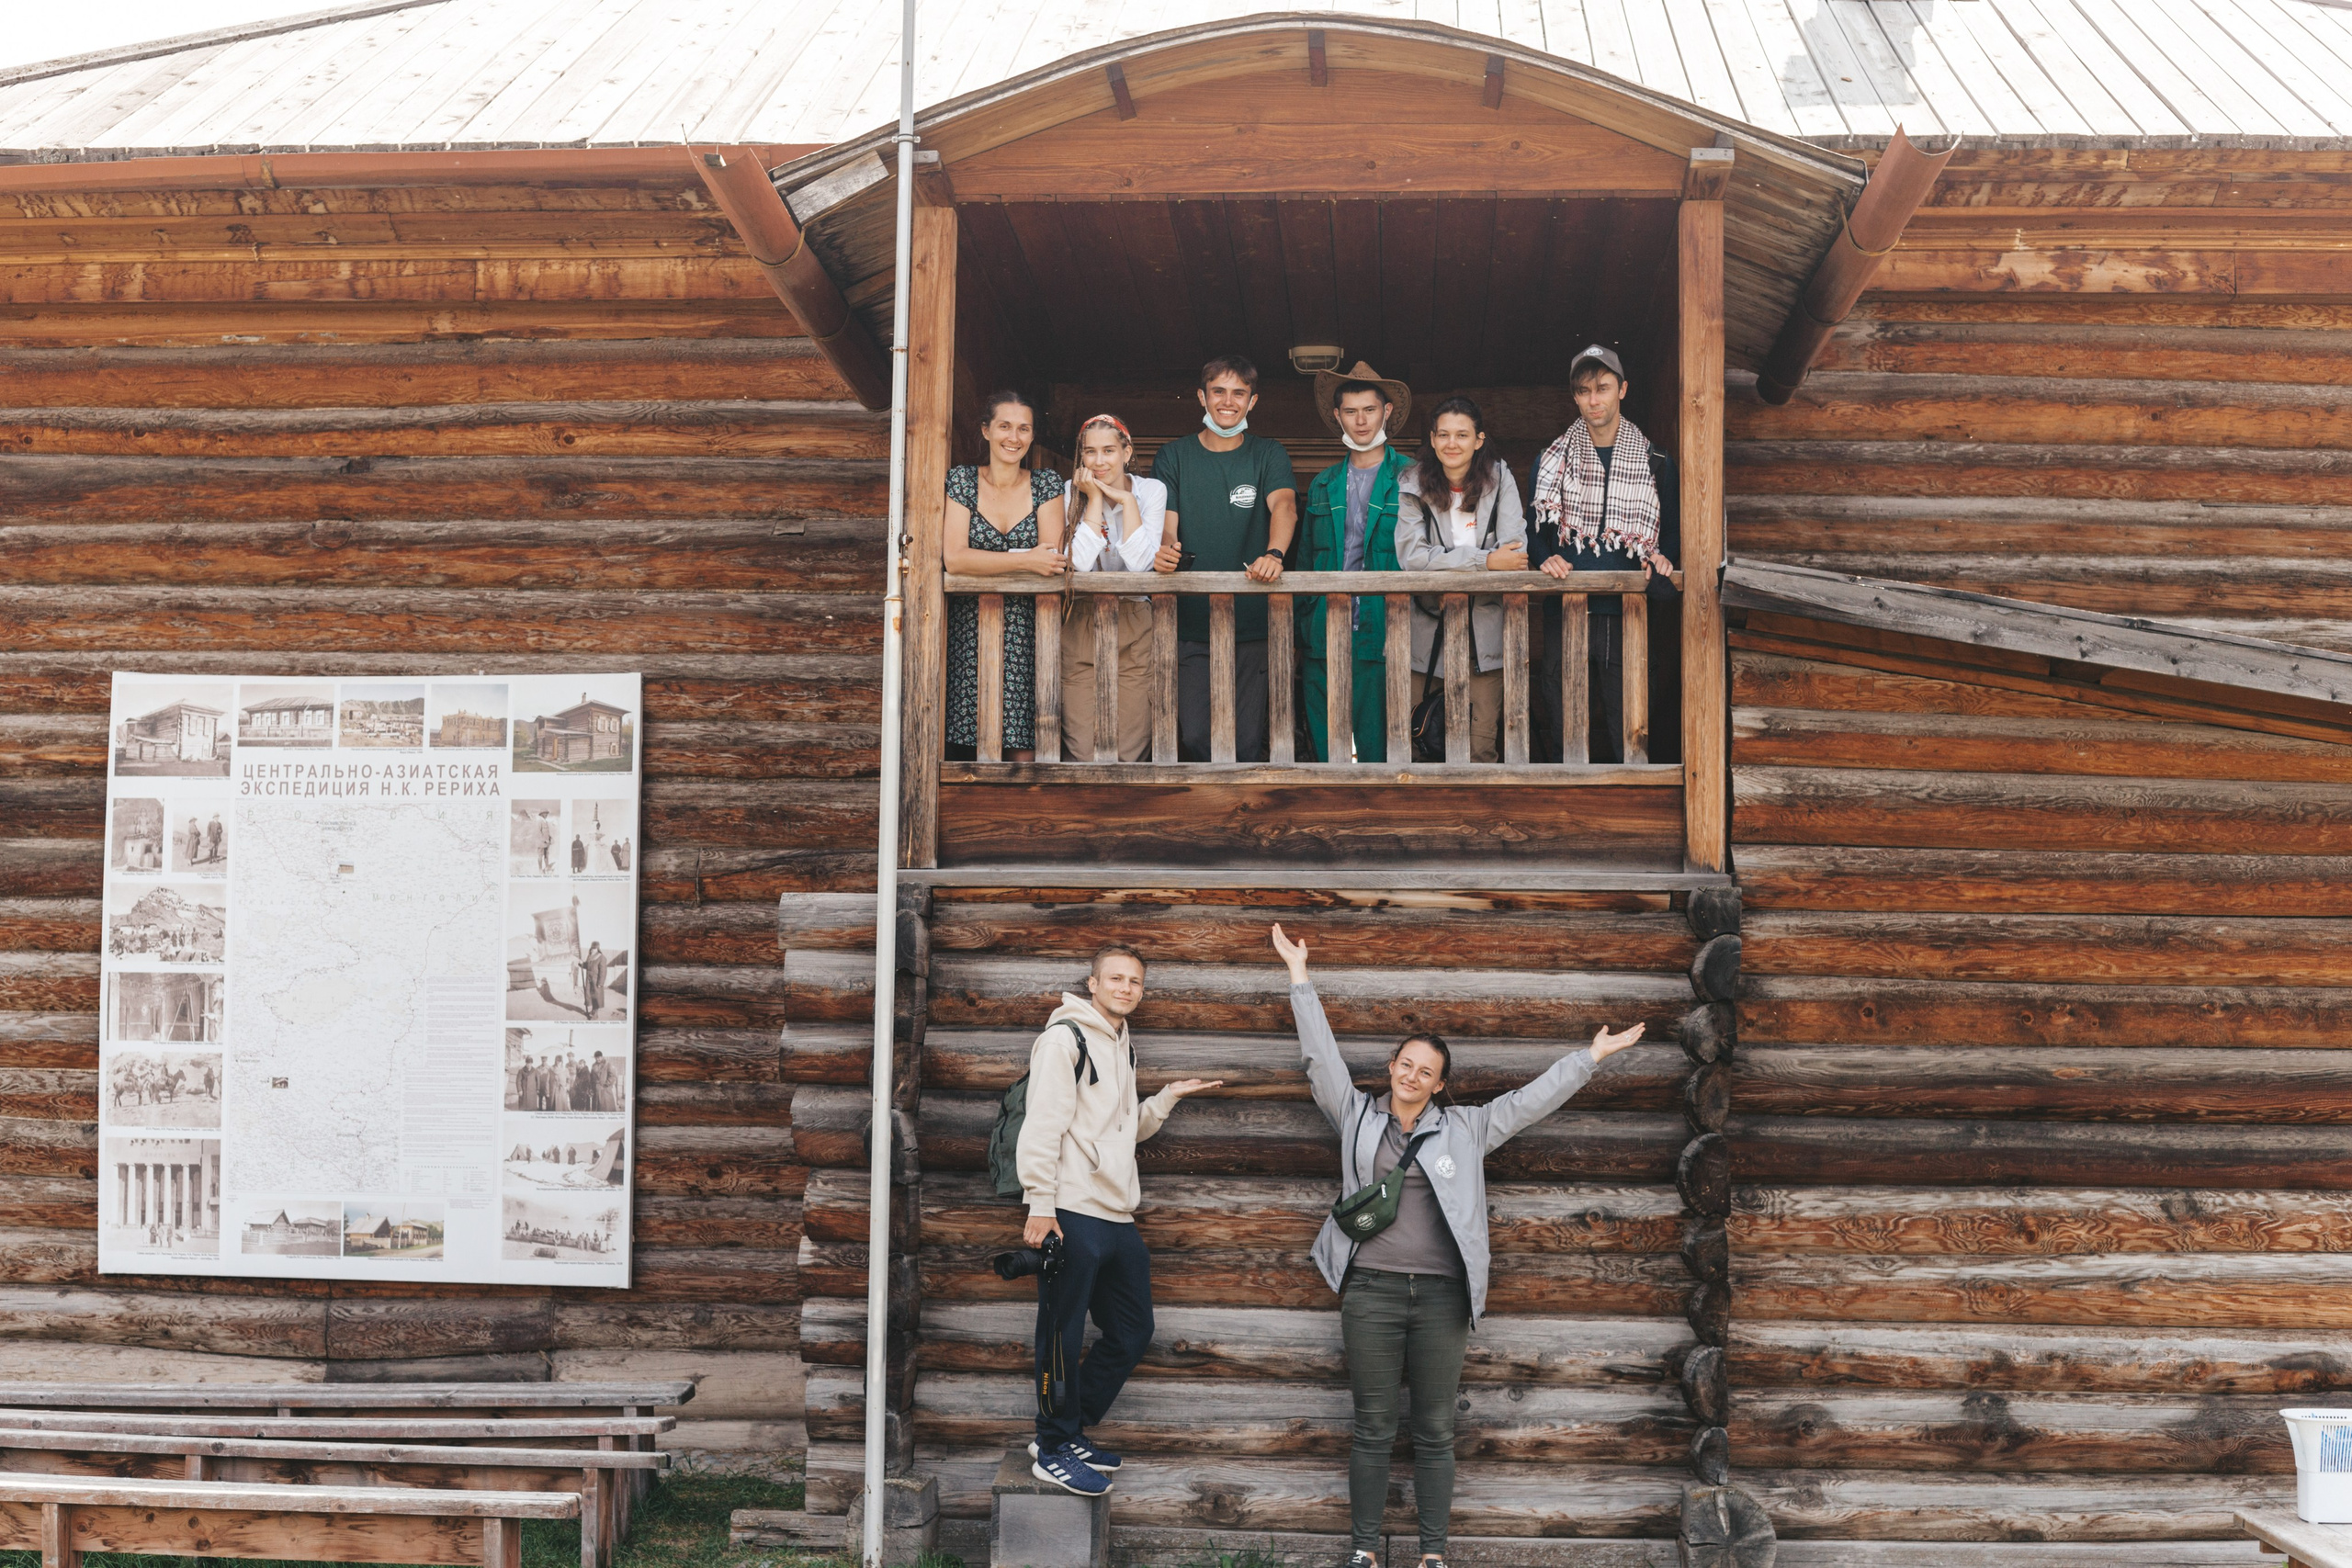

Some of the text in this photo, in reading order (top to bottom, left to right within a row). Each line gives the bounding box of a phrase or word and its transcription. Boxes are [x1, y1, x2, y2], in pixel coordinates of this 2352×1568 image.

[243, 764, 498, 780] ЦЕНТРАЛЬНО-АЗИАТСКАЯ
[241, 782, 369, 798] ЭКСПЕДИЦИЯ
[425, 782, 501, 796] РЕРИХА
[247, 810, 493, 820] РОССИЯ
